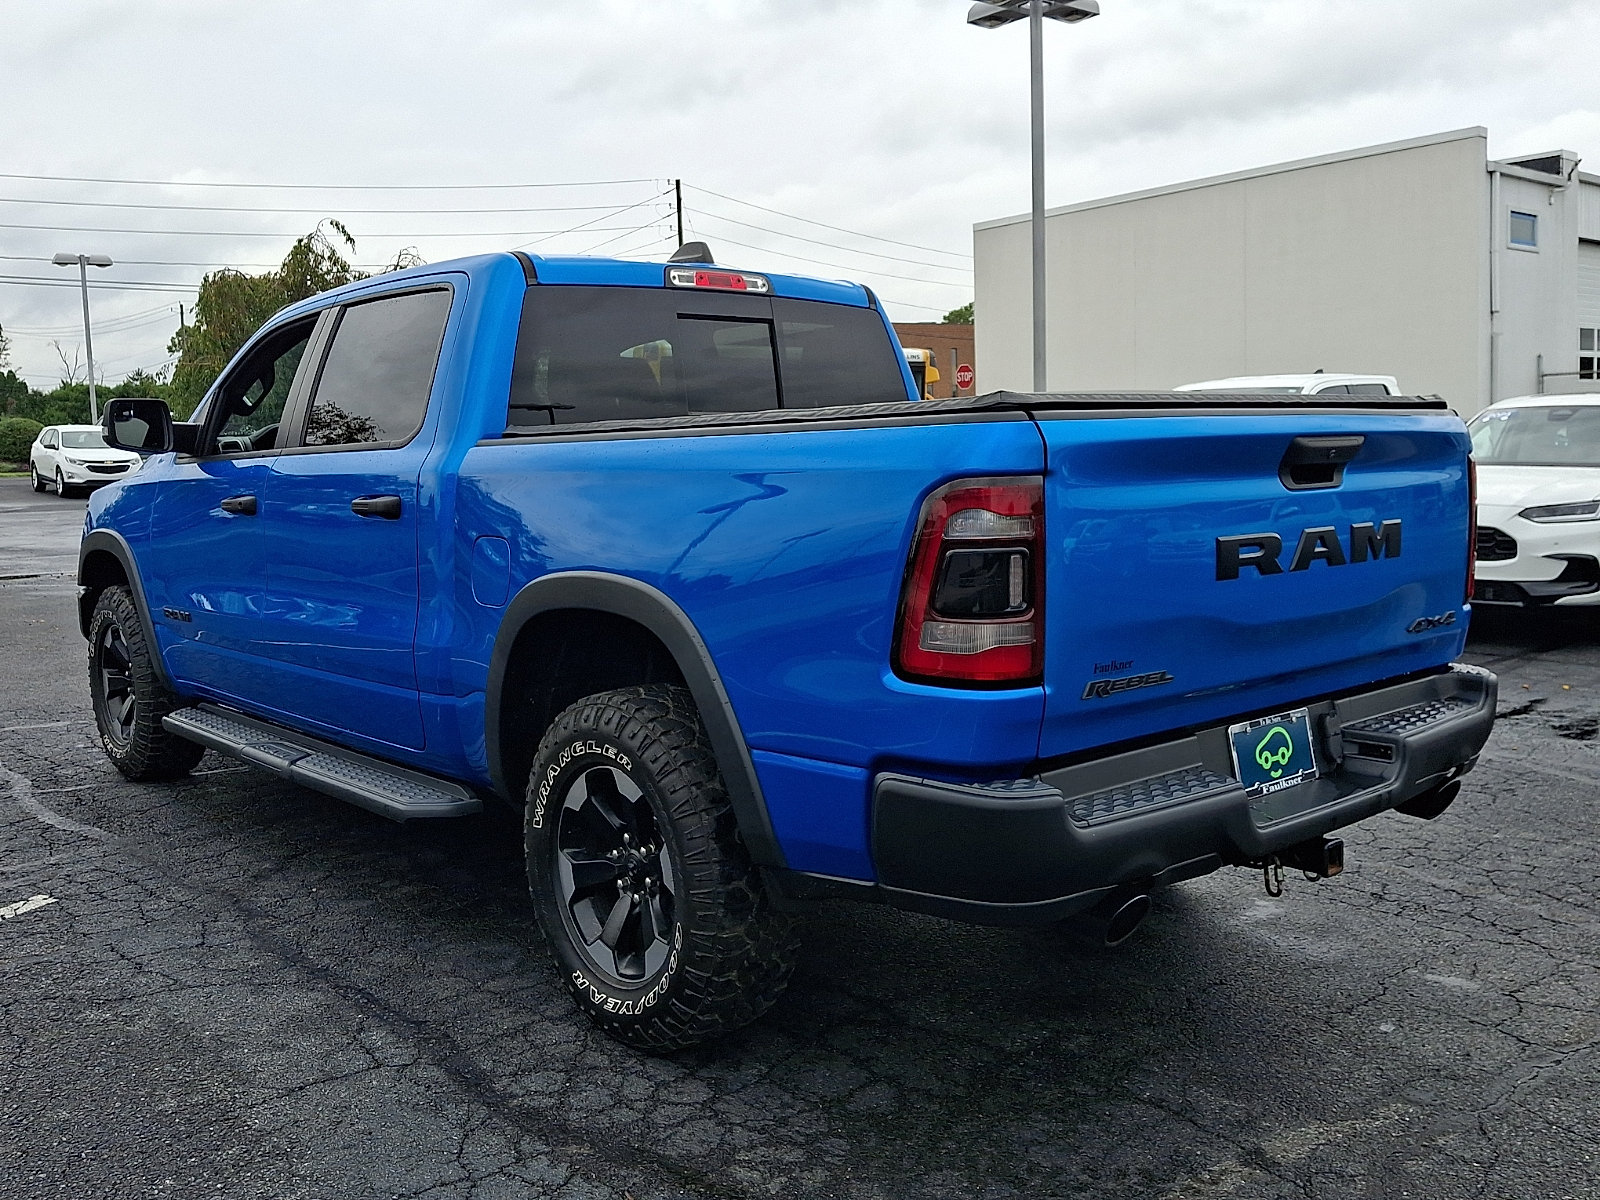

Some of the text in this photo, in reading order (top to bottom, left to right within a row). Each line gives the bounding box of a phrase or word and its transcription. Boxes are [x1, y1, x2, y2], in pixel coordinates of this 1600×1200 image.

[957, 371, 974, 382] STOP
[1215, 518, 1402, 582] RAM
[1093, 659, 1134, 674] Faulkner
[1081, 669, 1175, 700] REBEL
[532, 740, 633, 829] WRANGLER
[1262, 776, 1303, 795] Faulkner
[571, 921, 683, 1015] GOODYEAR
